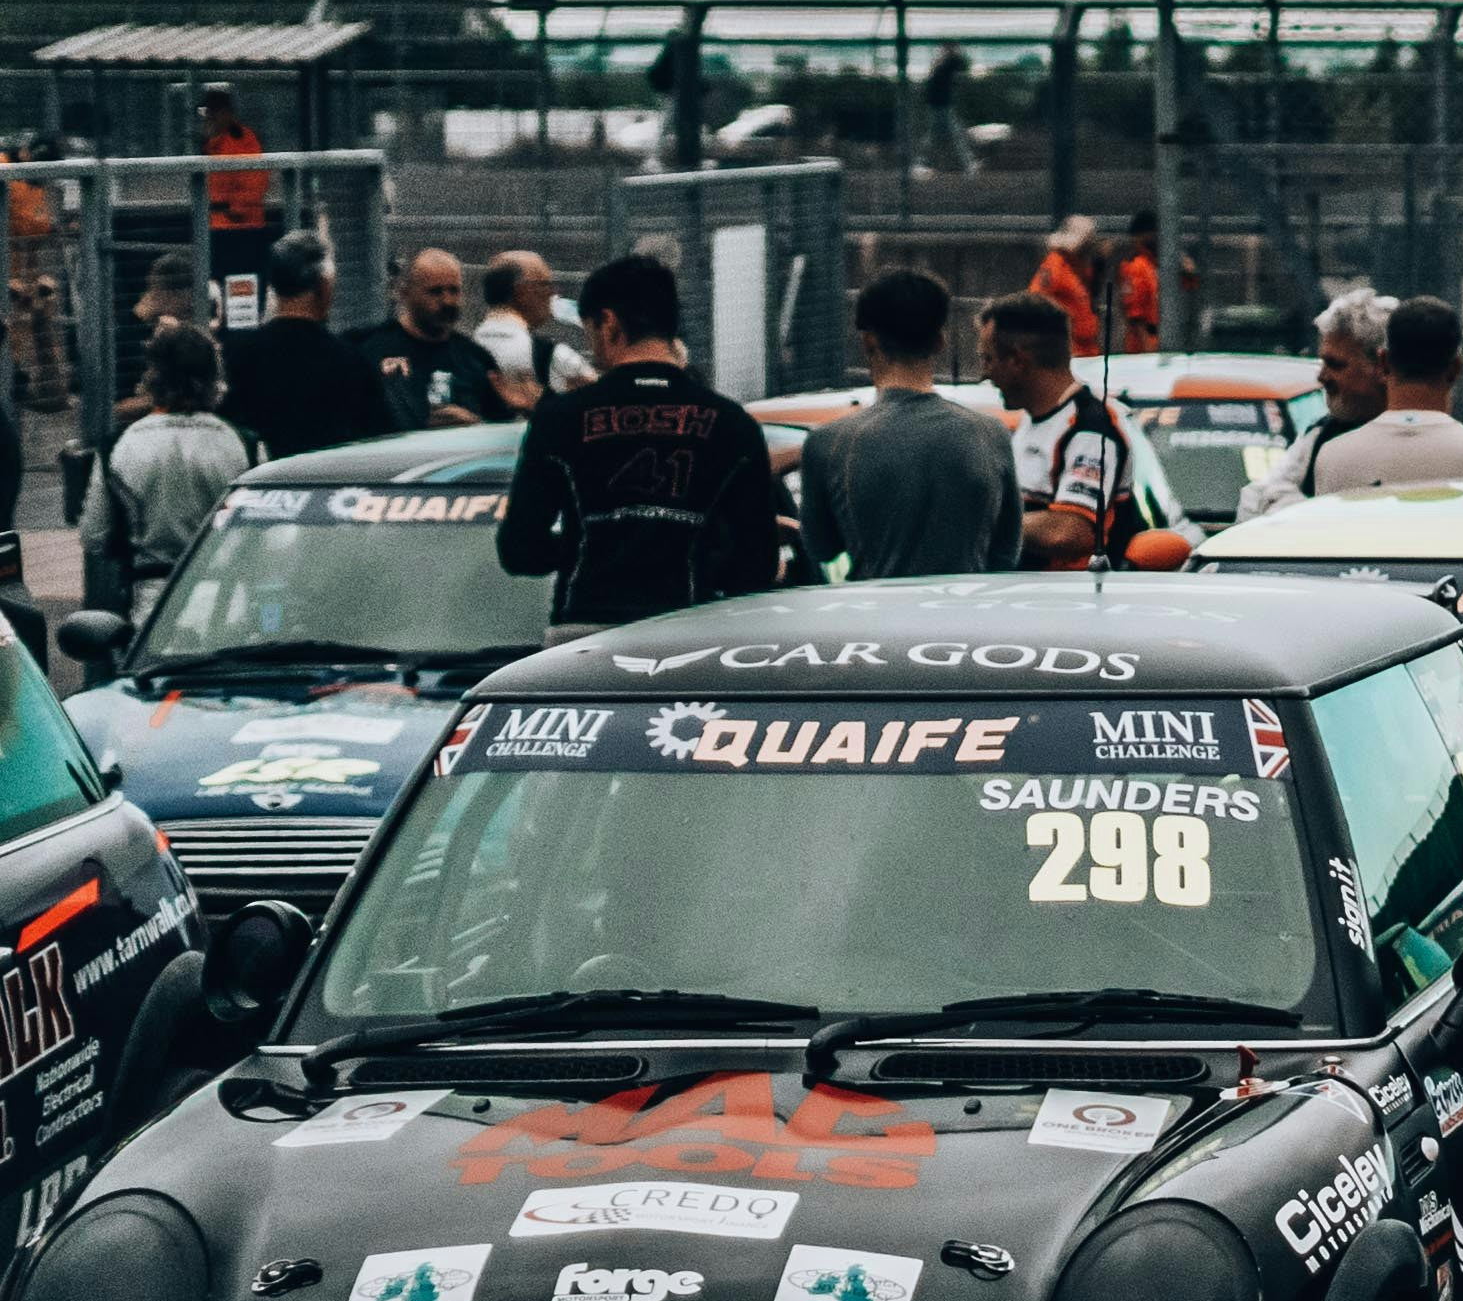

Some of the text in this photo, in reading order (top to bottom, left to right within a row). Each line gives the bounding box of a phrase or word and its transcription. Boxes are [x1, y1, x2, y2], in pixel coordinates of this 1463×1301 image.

[350, 494, 508, 523] QUAIF
[719, 642, 1141, 681] CAR GODS
[486, 737, 597, 760] CHALLENGE
[494, 708, 1220, 769] MINI QUAIFE MINI
[1095, 742, 1222, 762] CHALLENGE
[979, 779, 1261, 823] SAUNDERS
[1026, 811, 1211, 907] 298
[1332, 856, 1367, 950] signit
[1368, 1072, 1413, 1108] Ciceley
[36, 1091, 104, 1147] Contractors
[447, 1142, 920, 1190] TOOLS
[610, 1188, 778, 1220] CREDO
[1275, 1143, 1394, 1255] Ciceley
